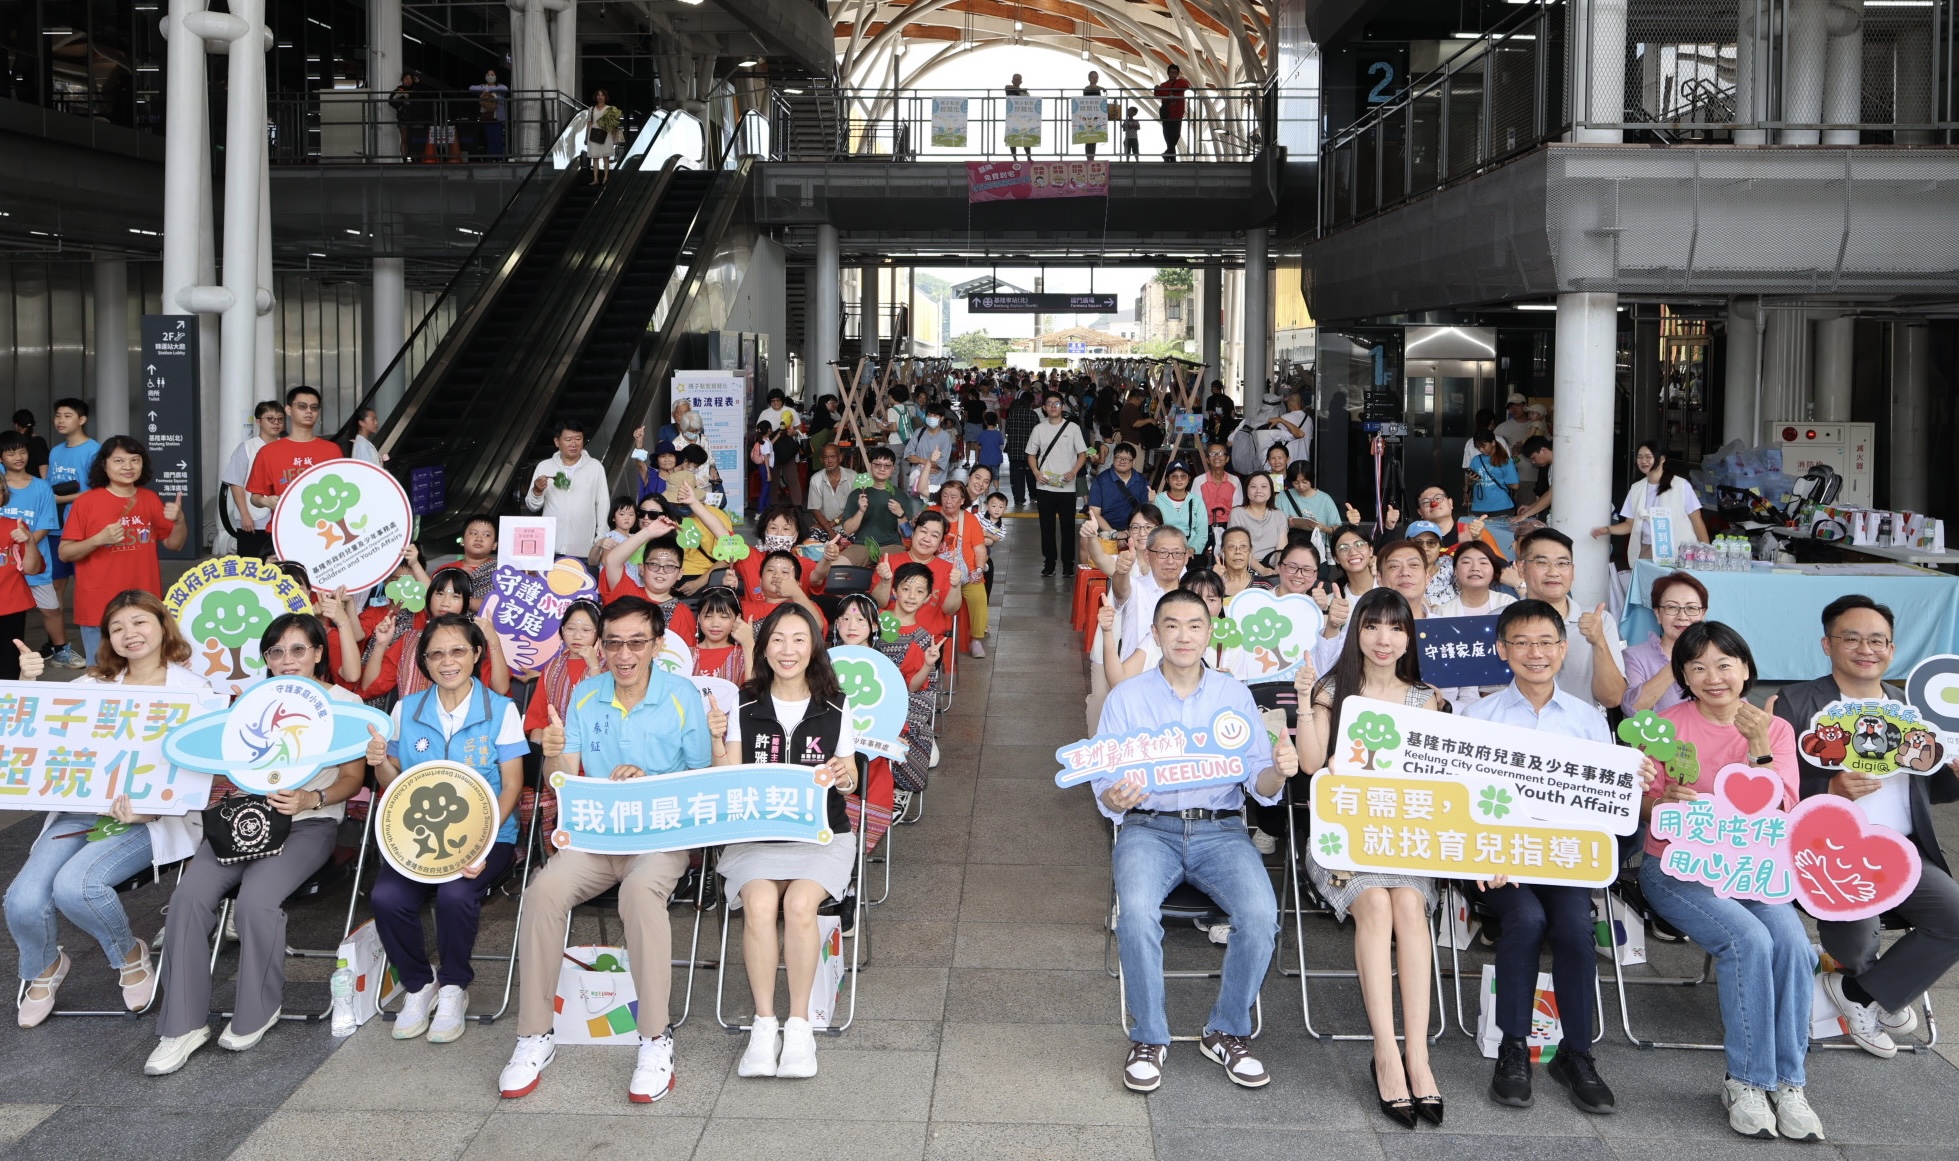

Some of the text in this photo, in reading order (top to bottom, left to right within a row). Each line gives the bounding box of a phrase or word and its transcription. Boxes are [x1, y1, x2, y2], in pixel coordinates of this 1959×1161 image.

[163, 332, 174, 341] 2F
[312, 522, 397, 574] 基隆市政府兒童及少年事務處
[1656, 520, 1669, 555] 簽到處
[318, 534, 403, 584] Children and Youth Affairs
[496, 569, 544, 606] 守護
[498, 599, 544, 637] 家庭
[0, 692, 191, 742] 親子默契
[275, 684, 328, 720] 守護家庭小衛星
[417, 769, 454, 783] Department
[1156, 758, 1242, 784] KEELUNG
[1404, 750, 1632, 802] Keelung City Government Department of
[1407, 730, 1634, 789] 基隆市政府兒童及少年事務處
[390, 784, 408, 810] Children
[454, 773, 487, 805] Government
[1515, 783, 1565, 804] Youth
[1570, 795, 1630, 817] Affairs
[571, 785, 814, 834] 我們最有默契!
[1659, 800, 1786, 846] 用愛陪伴
[385, 824, 394, 843] Youth
[479, 815, 491, 842] Keelung
[1362, 824, 1600, 869] 就找育兒指導!
[389, 842, 405, 862] Affairs
[405, 844, 482, 874] 基隆市政府兒童及少年事務處
[1668, 851, 1790, 897] 用心看見
